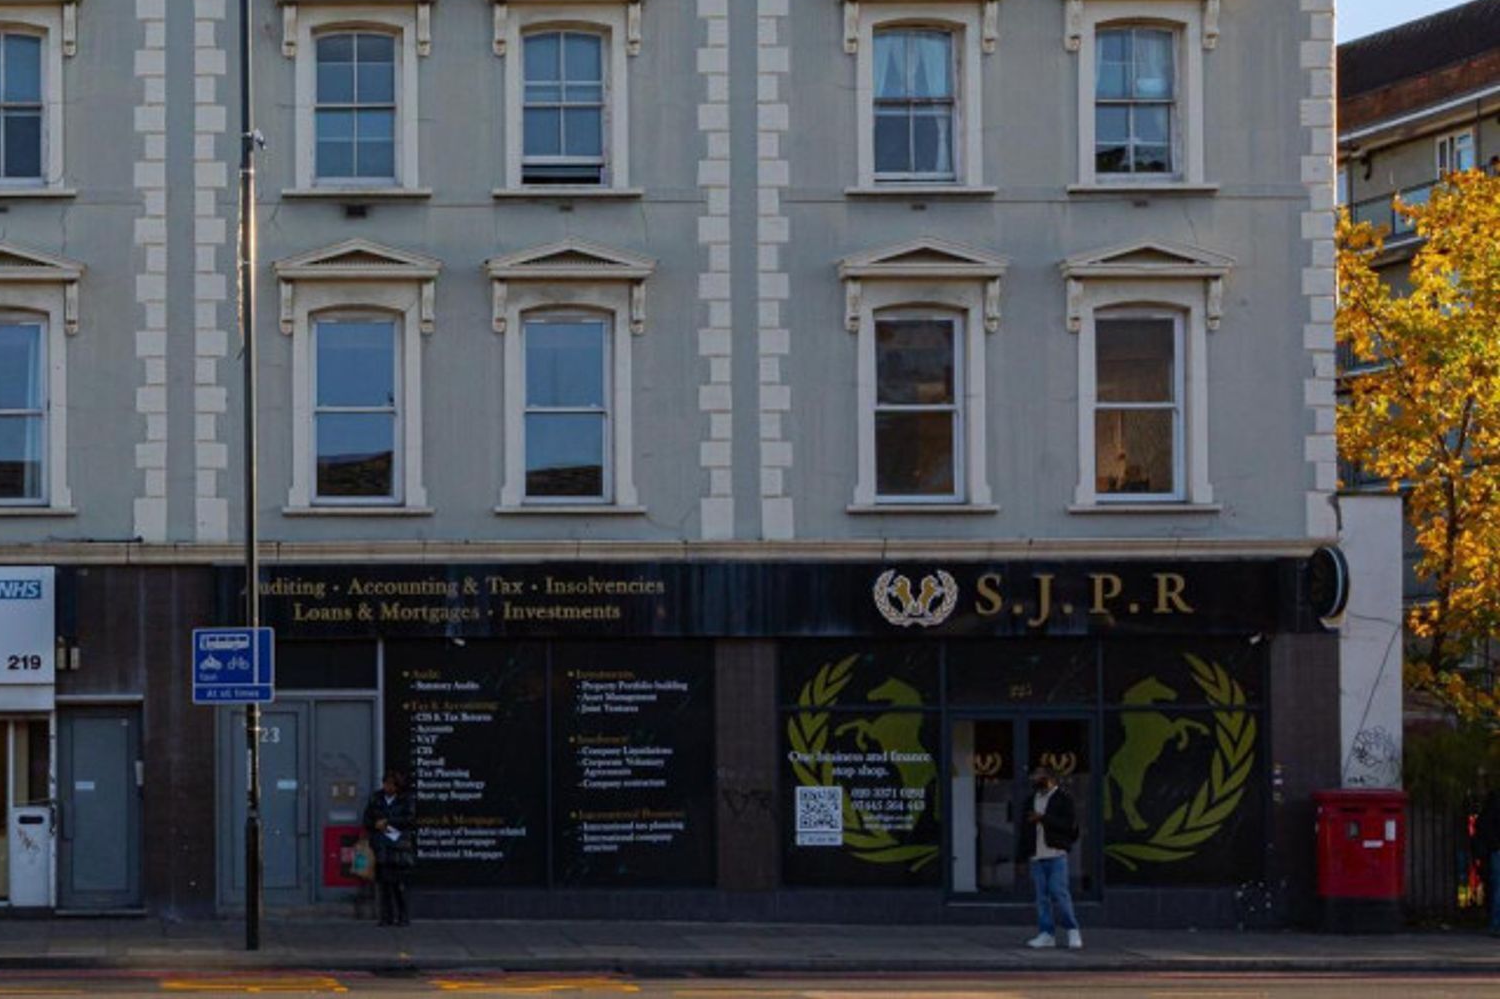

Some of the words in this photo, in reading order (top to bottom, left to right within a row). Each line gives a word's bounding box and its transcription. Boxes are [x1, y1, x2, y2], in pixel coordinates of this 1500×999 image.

[242, 577, 327, 598] uditing
[348, 576, 459, 598] Accounting
[463, 576, 479, 595] &
[485, 576, 525, 595] Tax
[546, 576, 666, 595] Insolvencies
[975, 572, 1195, 628] S.J.P.R
[293, 602, 353, 621] Loans
[357, 602, 373, 621] &
[380, 602, 480, 624] Mortgages
[503, 602, 621, 621] Investments
[7, 655, 42, 670] 219
